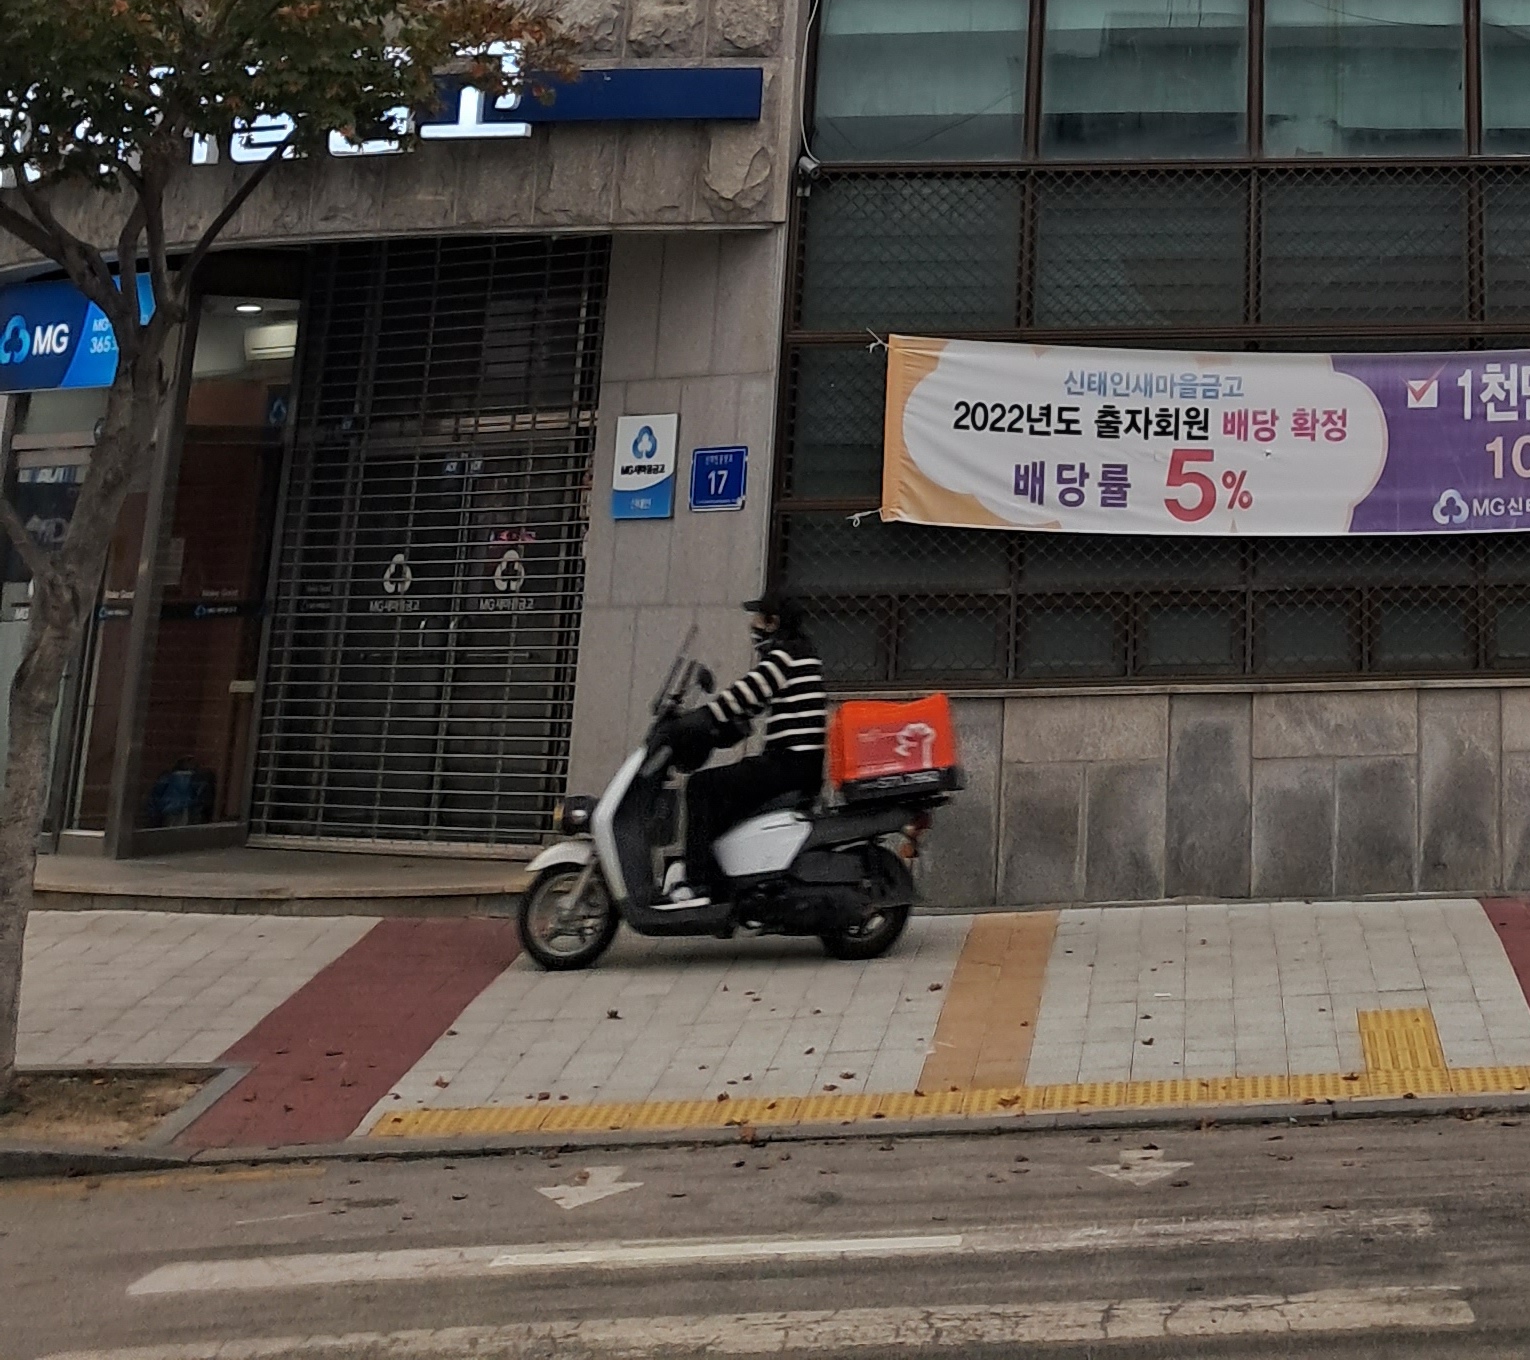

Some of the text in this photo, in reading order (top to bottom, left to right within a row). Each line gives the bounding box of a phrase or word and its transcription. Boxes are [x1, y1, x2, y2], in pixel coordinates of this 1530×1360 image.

[32, 323, 69, 356] MG
[1064, 370, 1245, 400] 신태인새마을금고
[952, 400, 1349, 443] 2022년도 출자회원 배당 확정
[707, 469, 729, 495] 17
[1013, 448, 1254, 523] 배당률 5%
